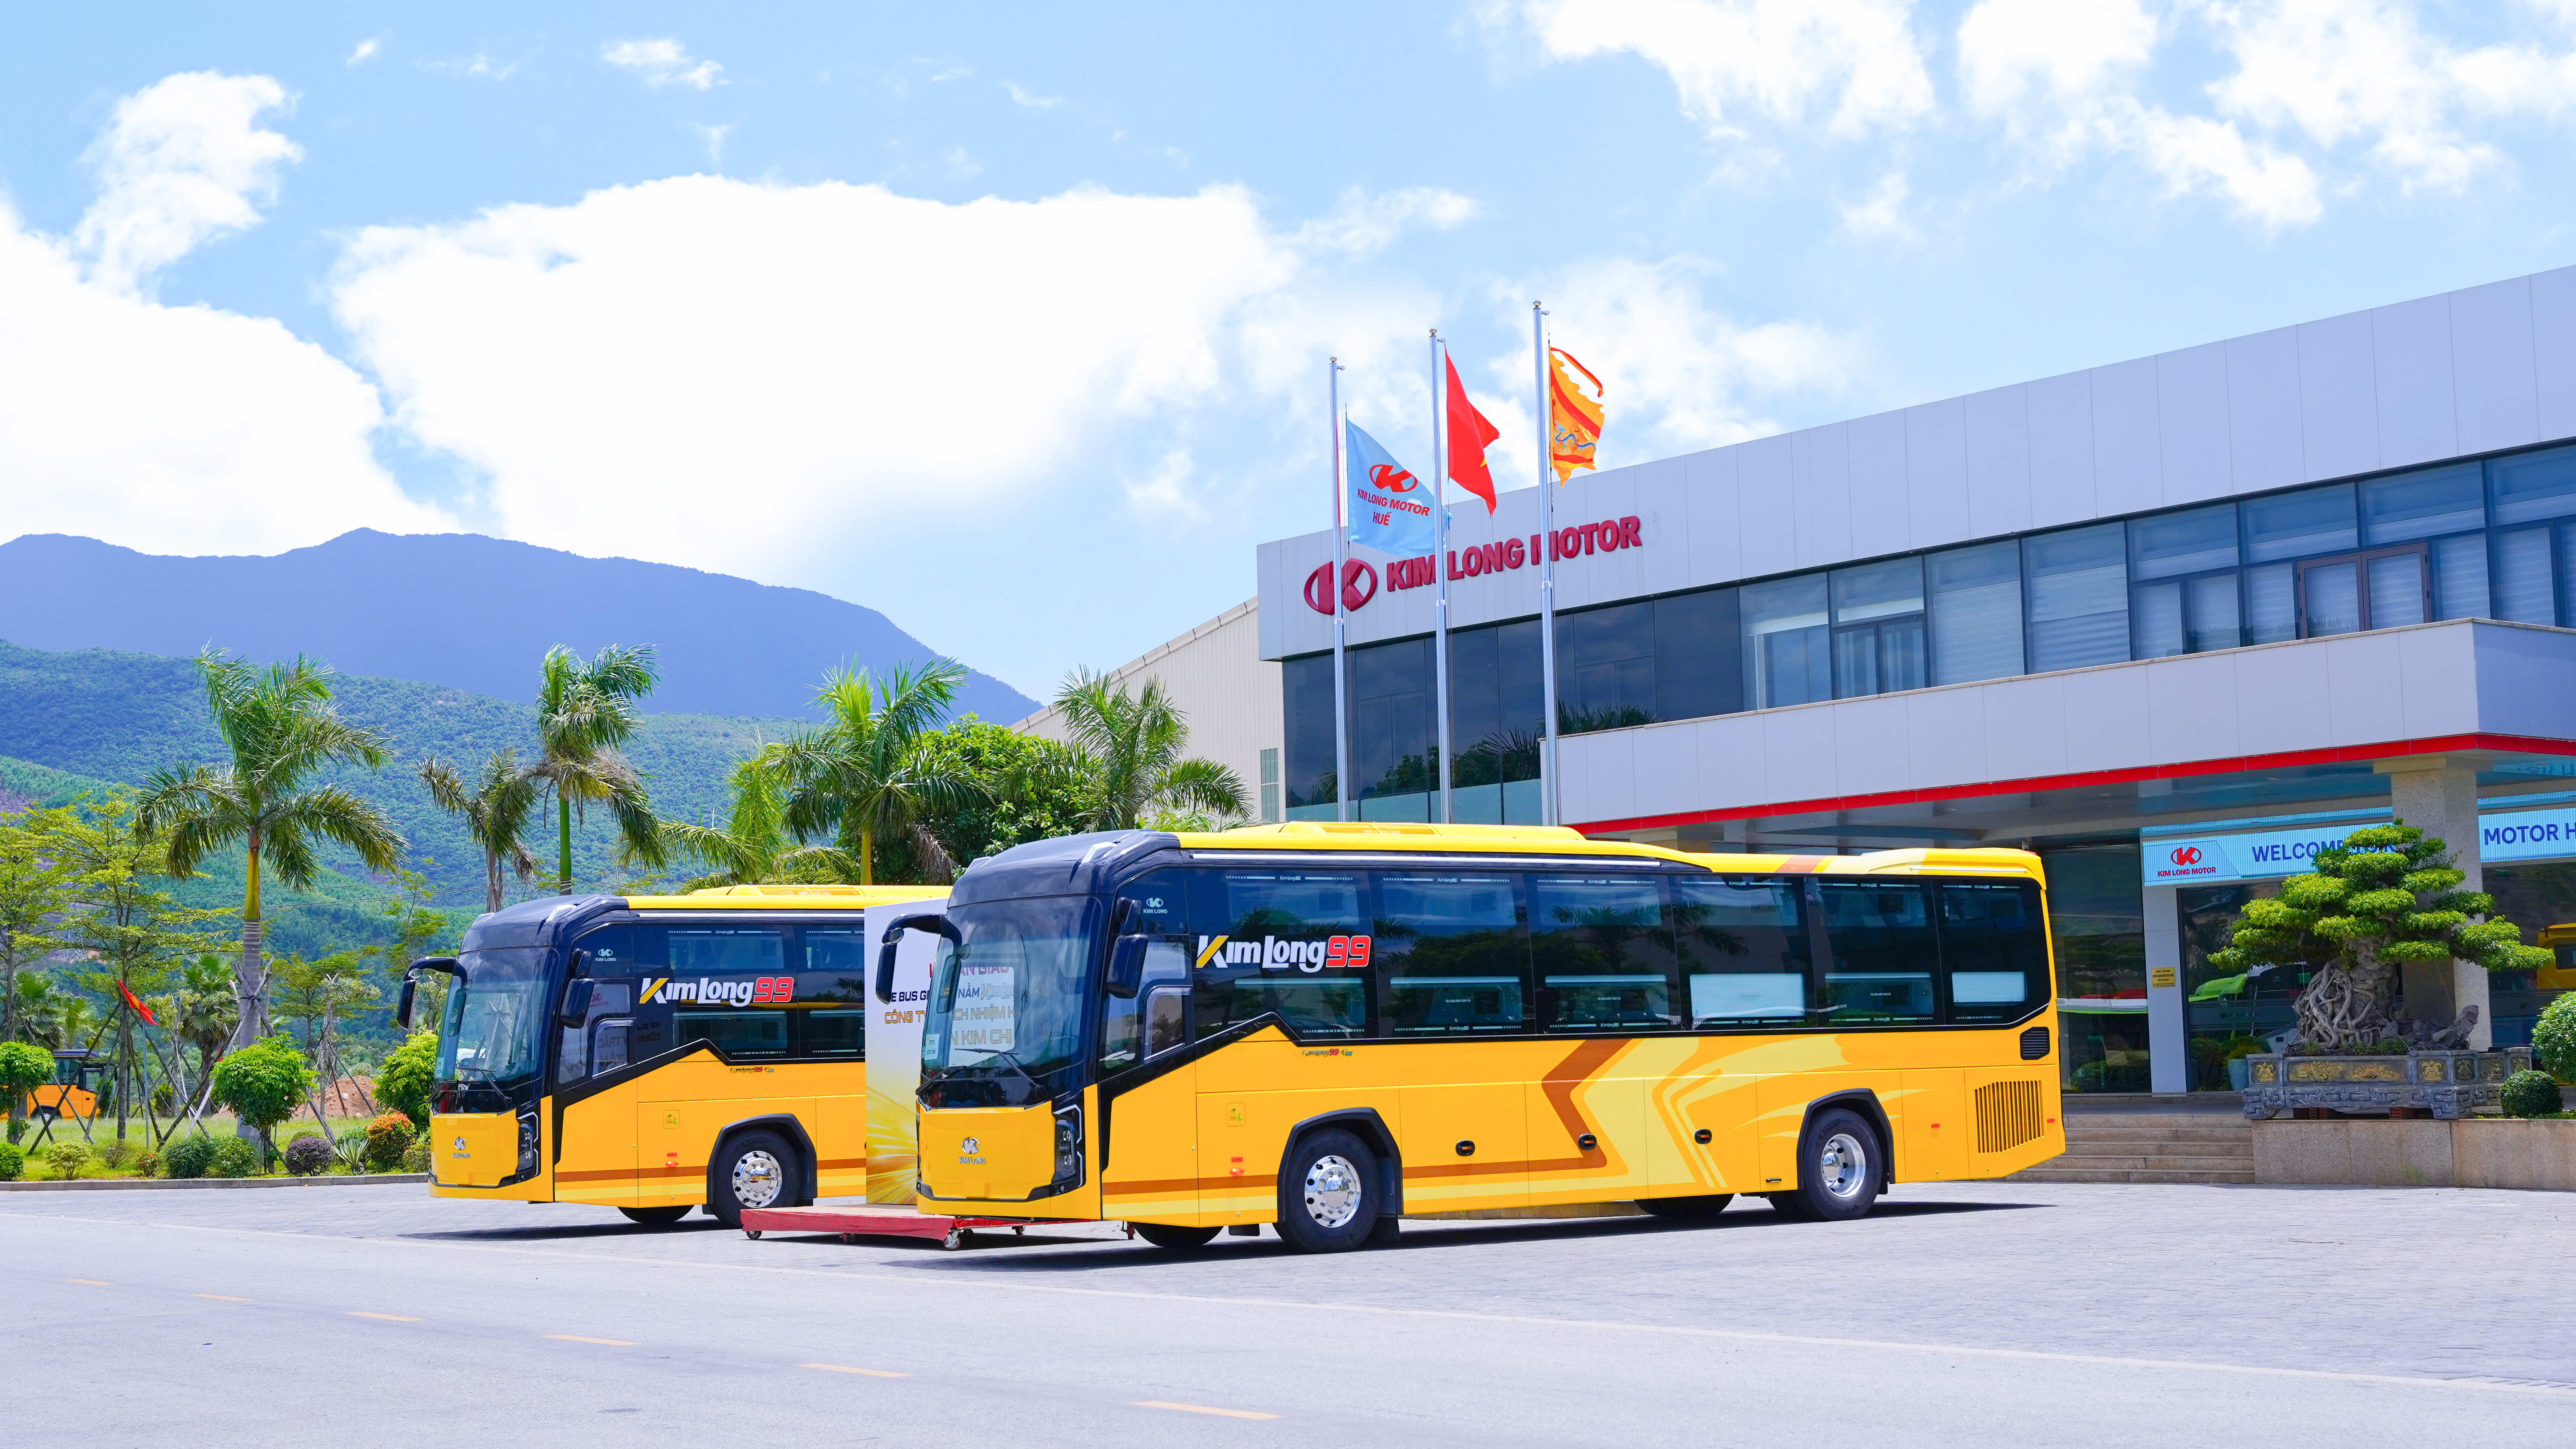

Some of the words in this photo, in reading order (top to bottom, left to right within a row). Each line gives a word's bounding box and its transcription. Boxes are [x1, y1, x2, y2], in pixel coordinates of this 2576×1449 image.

[1358, 488, 1367, 501] KIM
[1368, 493, 1388, 506] LONG
[1389, 499, 1430, 516] MOTOR
[1373, 512, 1392, 526] HUẾ
[1387, 555, 1436, 592] KIM
[1447, 538, 1524, 581] LONG
[1531, 515, 1642, 565] MOTOR
[2484, 824, 2559, 845] MOTOR
[899, 991, 917, 1002] BUS
[958, 982, 980, 998] NẰM
[884, 1009, 913, 1024] CÔNG
[971, 1003, 1005, 1022] NHIỆM
[962, 1030, 986, 1045] KIM
[990, 1029, 1012, 1044] CHI
